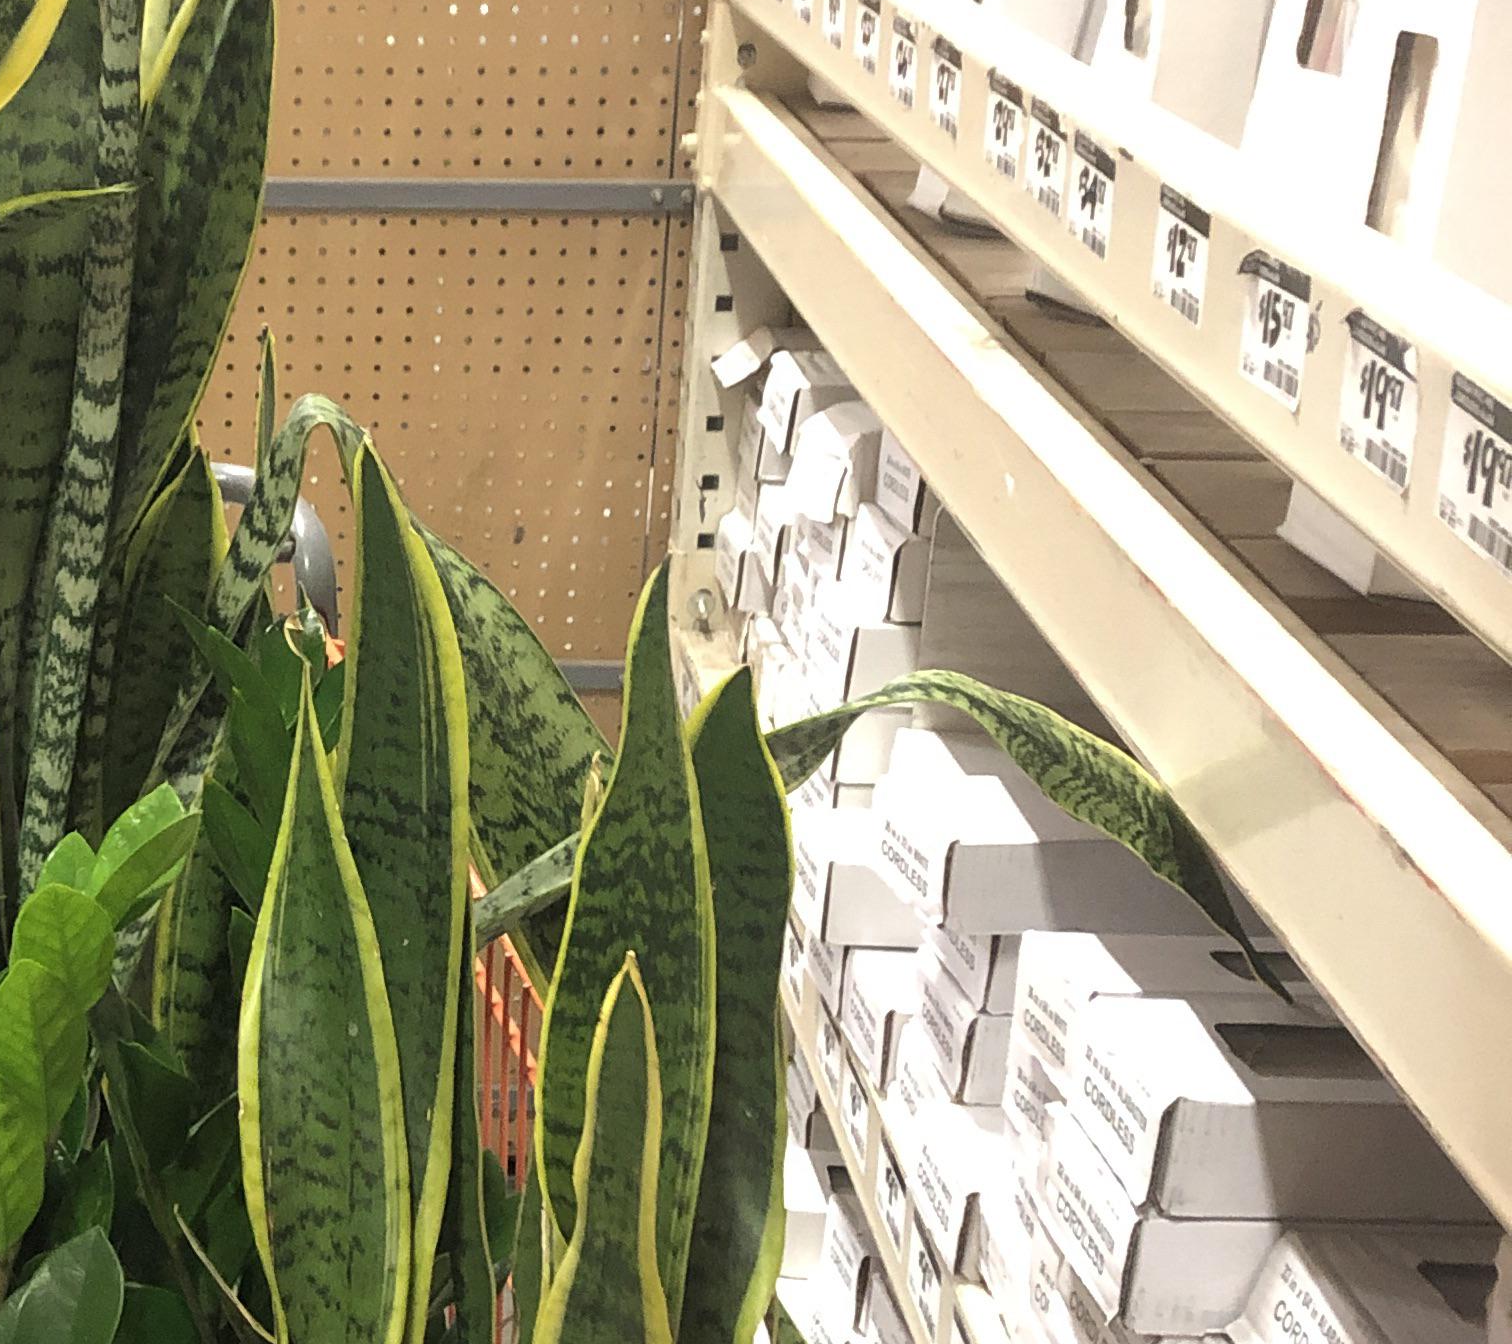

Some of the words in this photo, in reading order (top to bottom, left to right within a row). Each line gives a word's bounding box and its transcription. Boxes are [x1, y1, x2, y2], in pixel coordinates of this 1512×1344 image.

[881, 839, 928, 897] CORDLESS
[1023, 1009, 1066, 1067] CORDLESS
[1083, 1076, 1135, 1155] CORDLESS
[1056, 1191, 1105, 1276] CORDLESS
